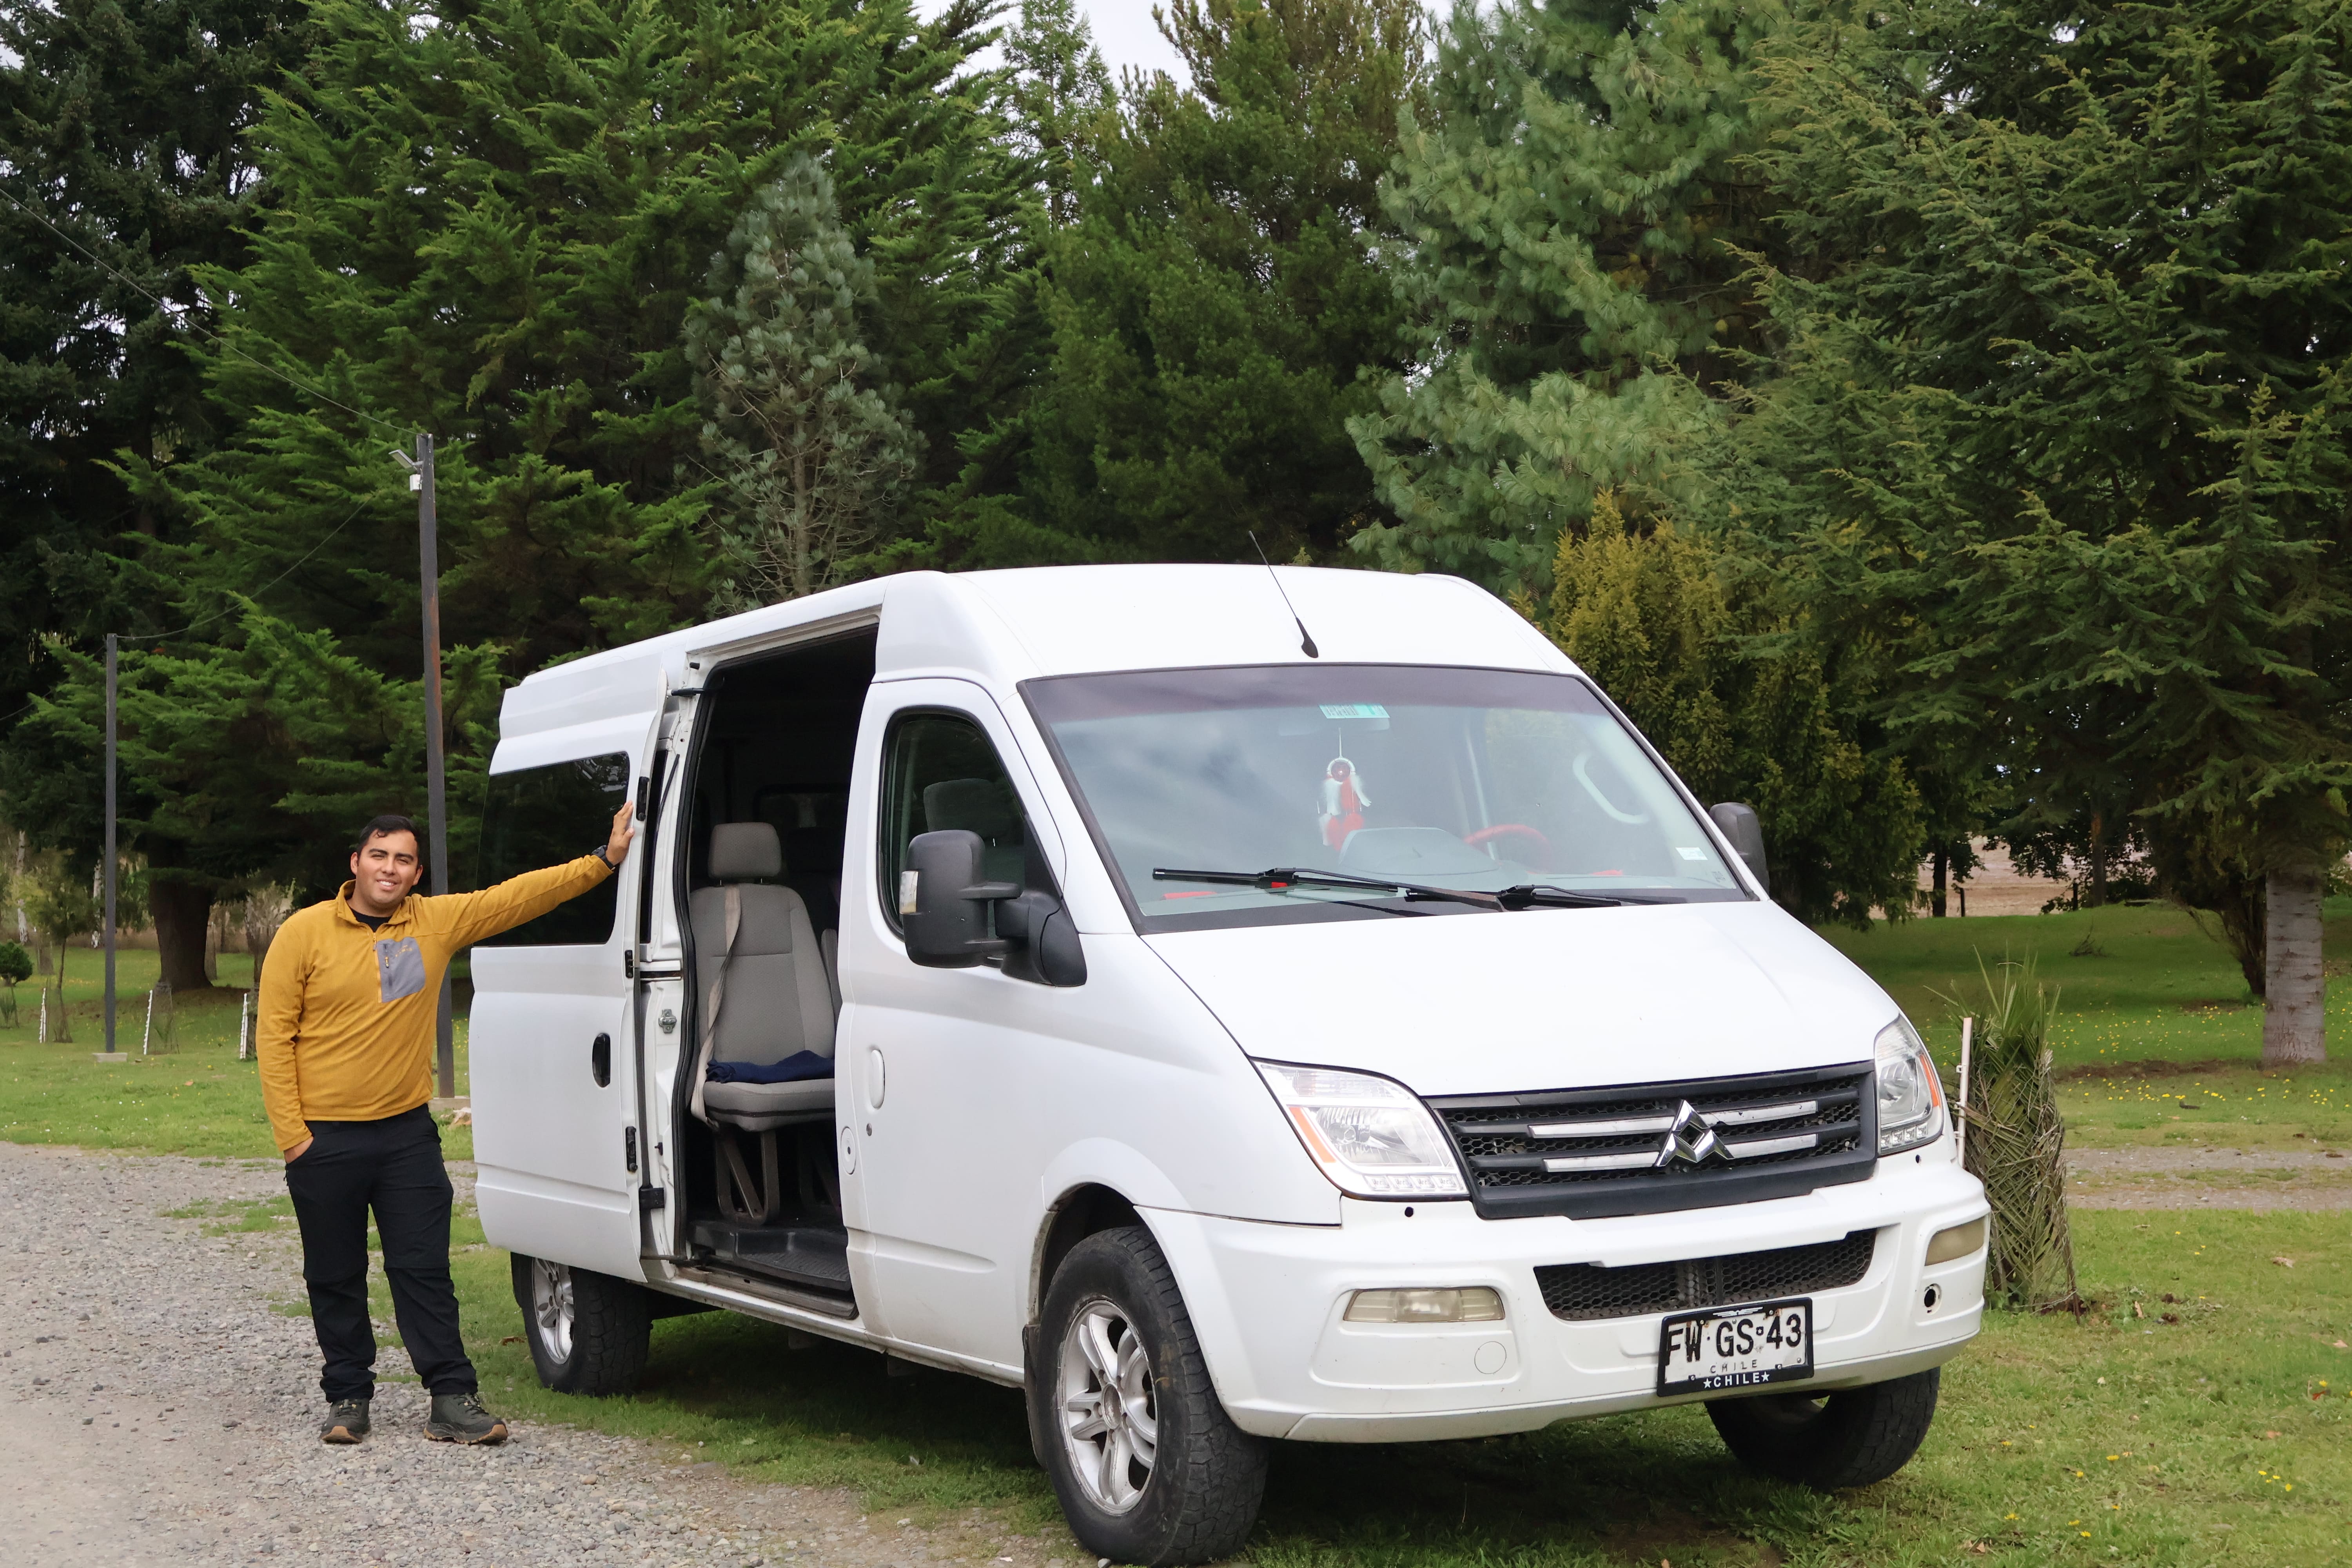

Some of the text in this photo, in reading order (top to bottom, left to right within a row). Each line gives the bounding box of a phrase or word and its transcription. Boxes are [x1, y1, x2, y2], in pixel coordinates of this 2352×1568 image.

[1666, 1314, 1801, 1366] FW GS 43
[1710, 1359, 1758, 1373] CHILE
[1713, 1372, 1760, 1388] CHILE
